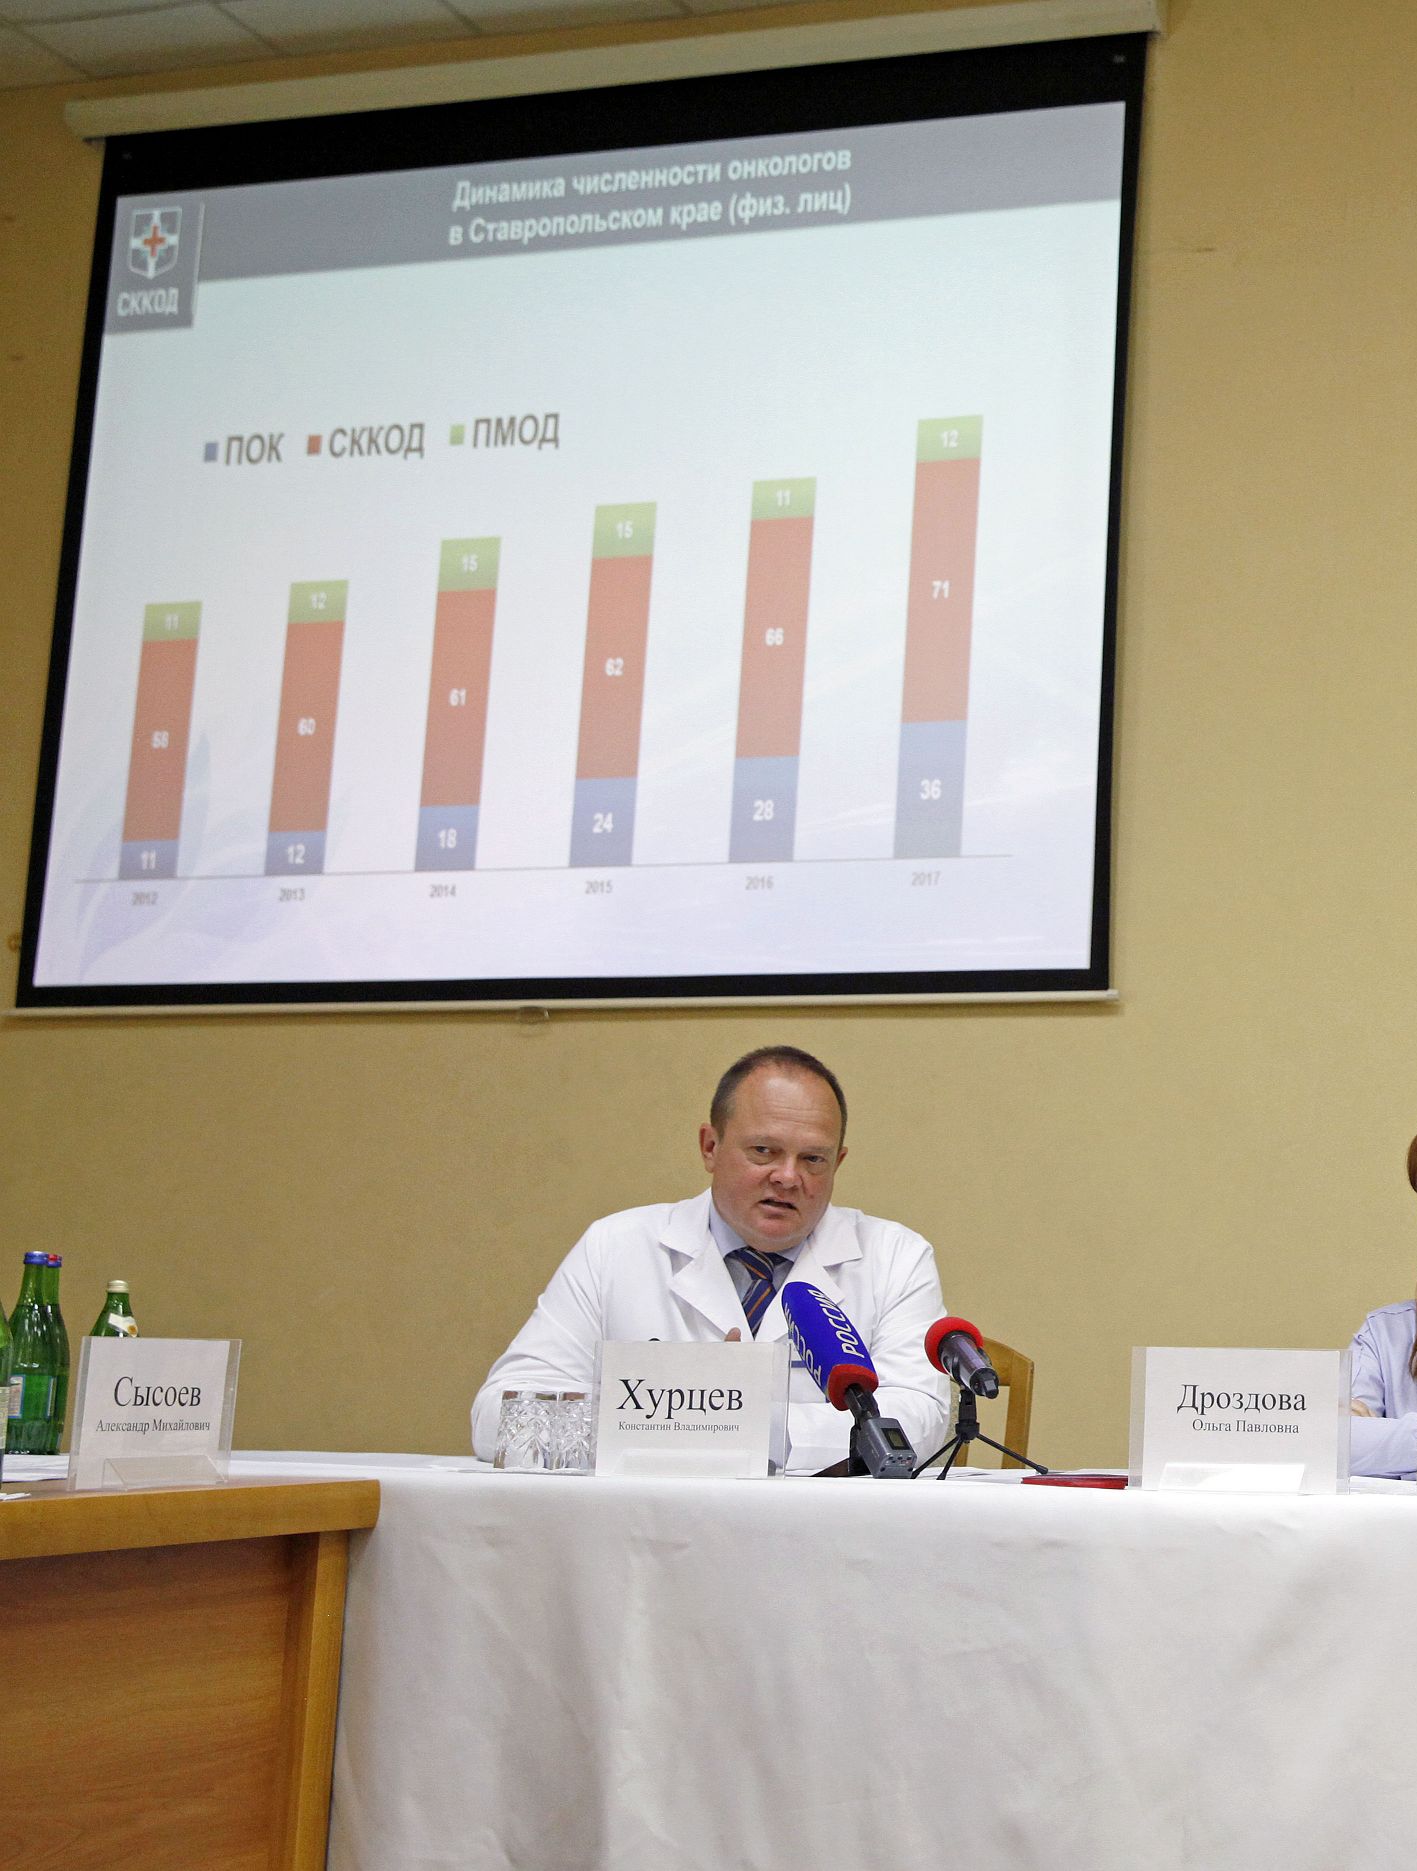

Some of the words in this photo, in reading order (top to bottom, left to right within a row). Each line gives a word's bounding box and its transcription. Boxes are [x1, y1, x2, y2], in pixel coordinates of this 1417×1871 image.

[453, 174, 566, 212] Динамика
[572, 160, 720, 197] численности
[728, 146, 851, 182] онкологов
[448, 222, 463, 246] в
[469, 206, 663, 246] Ставропольском
[670, 200, 722, 232] крае
[729, 190, 792, 227] (физ.
[797, 182, 851, 217] лиц)
[116, 286, 180, 317] СККОД
[225, 433, 285, 466] ПОК
[329, 422, 426, 461] СККОД
[471, 413, 561, 450] ПМОД
[940, 430, 959, 448] 12
[776, 489, 791, 506] 11
[615, 521, 633, 539] 15
[461, 554, 478, 572] 15
[931, 581, 950, 599] 71
[765, 628, 784, 646] 66
[605, 658, 624, 676] 62
[449, 689, 466, 706] 61
[920, 780, 941, 799] 36
[753, 801, 774, 821] 28
[592, 813, 613, 833] 24
[438, 829, 457, 849] 18
[141, 851, 157, 870] 11
[287, 844, 306, 864] 12
[429, 884, 456, 899] 2014
[585, 880, 612, 895] 2015
[745, 876, 774, 891] 2016
[911, 872, 941, 887] 2017
[807, 1288, 865, 1358] РОССИЯ
[113, 1375, 202, 1408] Сысоев
[617, 1378, 743, 1420] Хурцев
[1176, 1384, 1308, 1416] Дроздова
[96, 1418, 150, 1435] Александр
[152, 1418, 211, 1433] Михайлович
[618, 1421, 671, 1432] Константин
[673, 1421, 740, 1433] Владимирович
[1192, 1418, 1232, 1434] Ольга
[1235, 1418, 1300, 1435] Павловна
